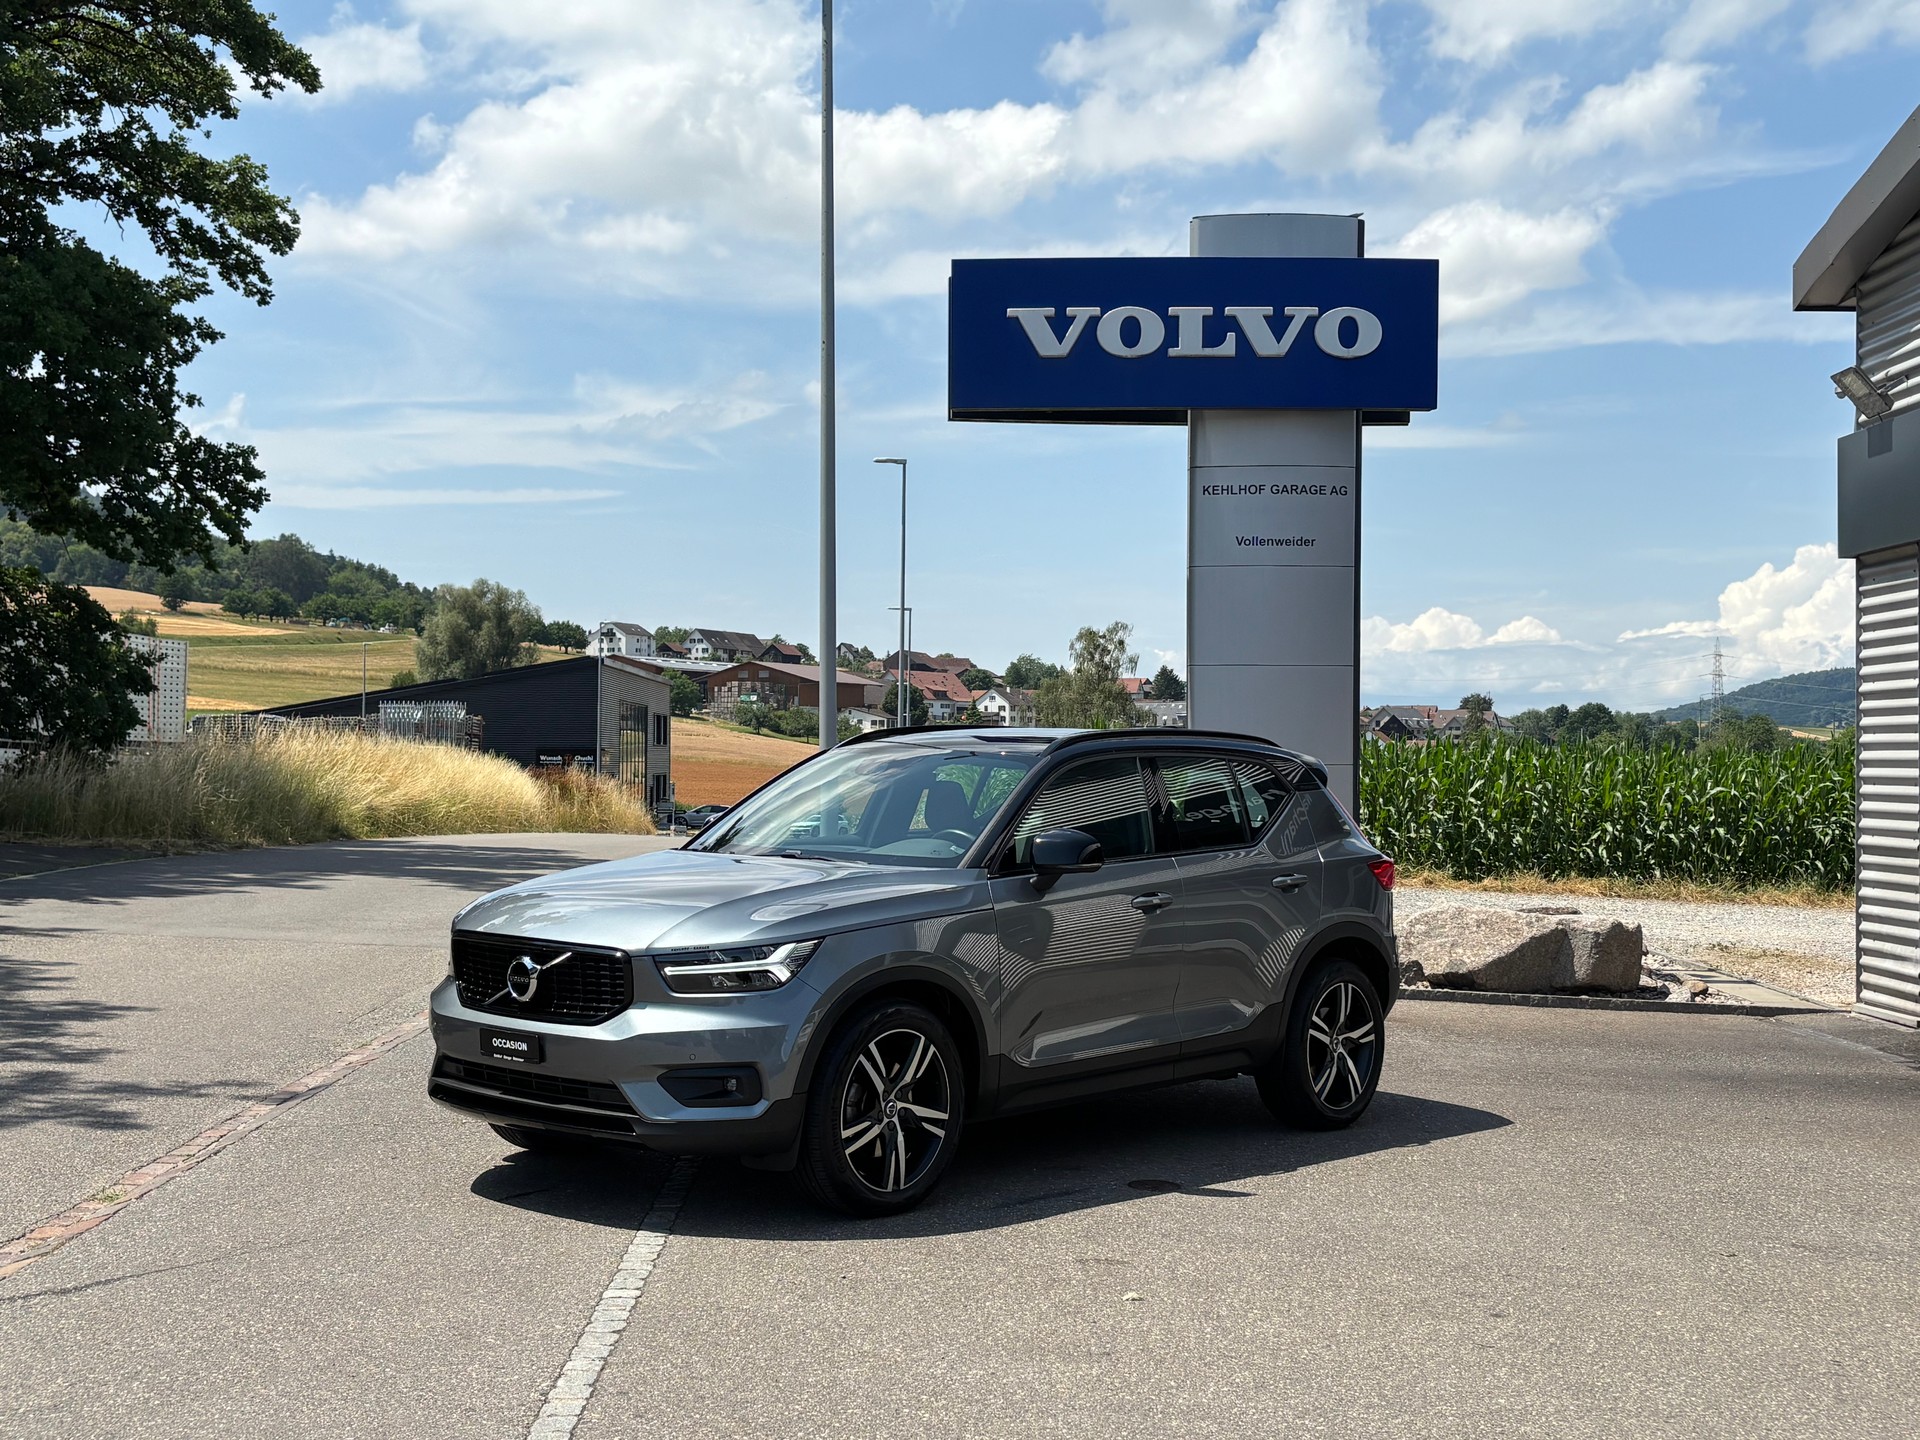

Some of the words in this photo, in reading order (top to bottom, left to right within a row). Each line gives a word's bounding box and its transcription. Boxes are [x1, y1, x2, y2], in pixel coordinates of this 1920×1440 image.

[1006, 305, 1383, 359] VOLVO
[1202, 484, 1267, 496] KEHLHOF
[1270, 484, 1327, 496] GARAGE
[1329, 485, 1349, 496] AG
[1235, 535, 1317, 547] Vollenweider
[492, 1037, 528, 1051] OCCASION
